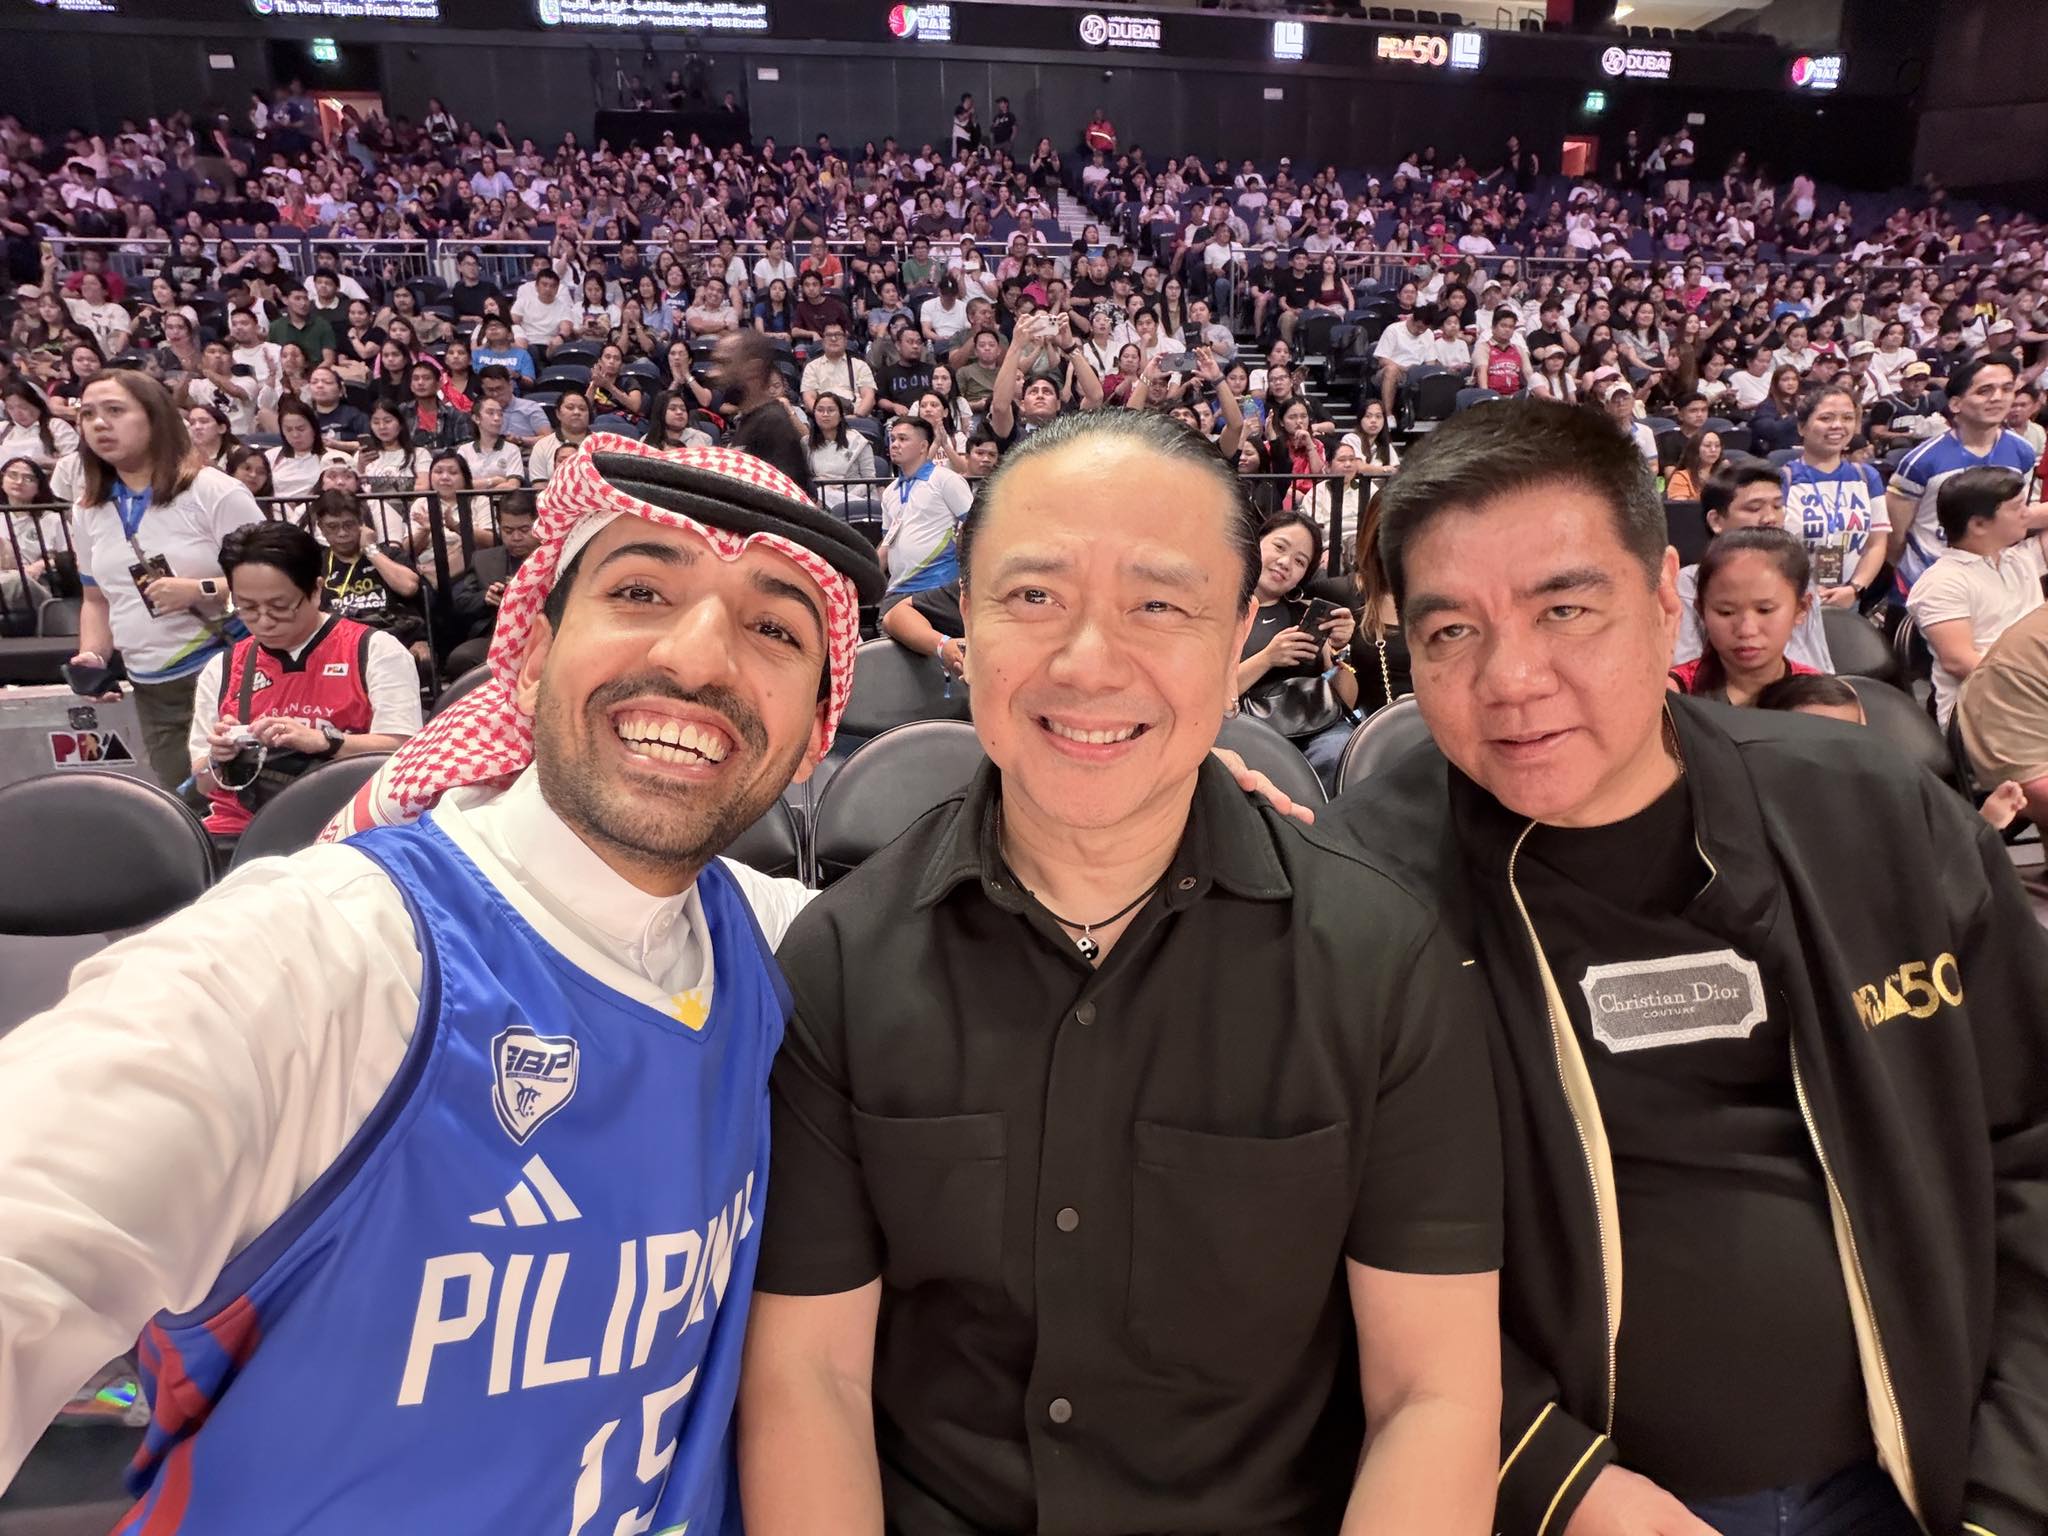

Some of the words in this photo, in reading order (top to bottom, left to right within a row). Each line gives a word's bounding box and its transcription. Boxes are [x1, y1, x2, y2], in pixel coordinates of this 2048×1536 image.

[274, 0, 297, 13] The
[297, 1, 321, 14] New
[323, 2, 363, 17] Filipino
[365, 4, 400, 16] Private
[402, 5, 440, 18] School
[1107, 22, 1161, 41] DUBAI
[1626, 54, 1672, 72] DUBAI
[892, 374, 930, 391] ICON
[50, 732, 134, 763] PBA
[1599, 990, 1686, 1014] Christian
[1688, 981, 1740, 1003] Dior
[1642, 1006, 1697, 1019] COUTURE
